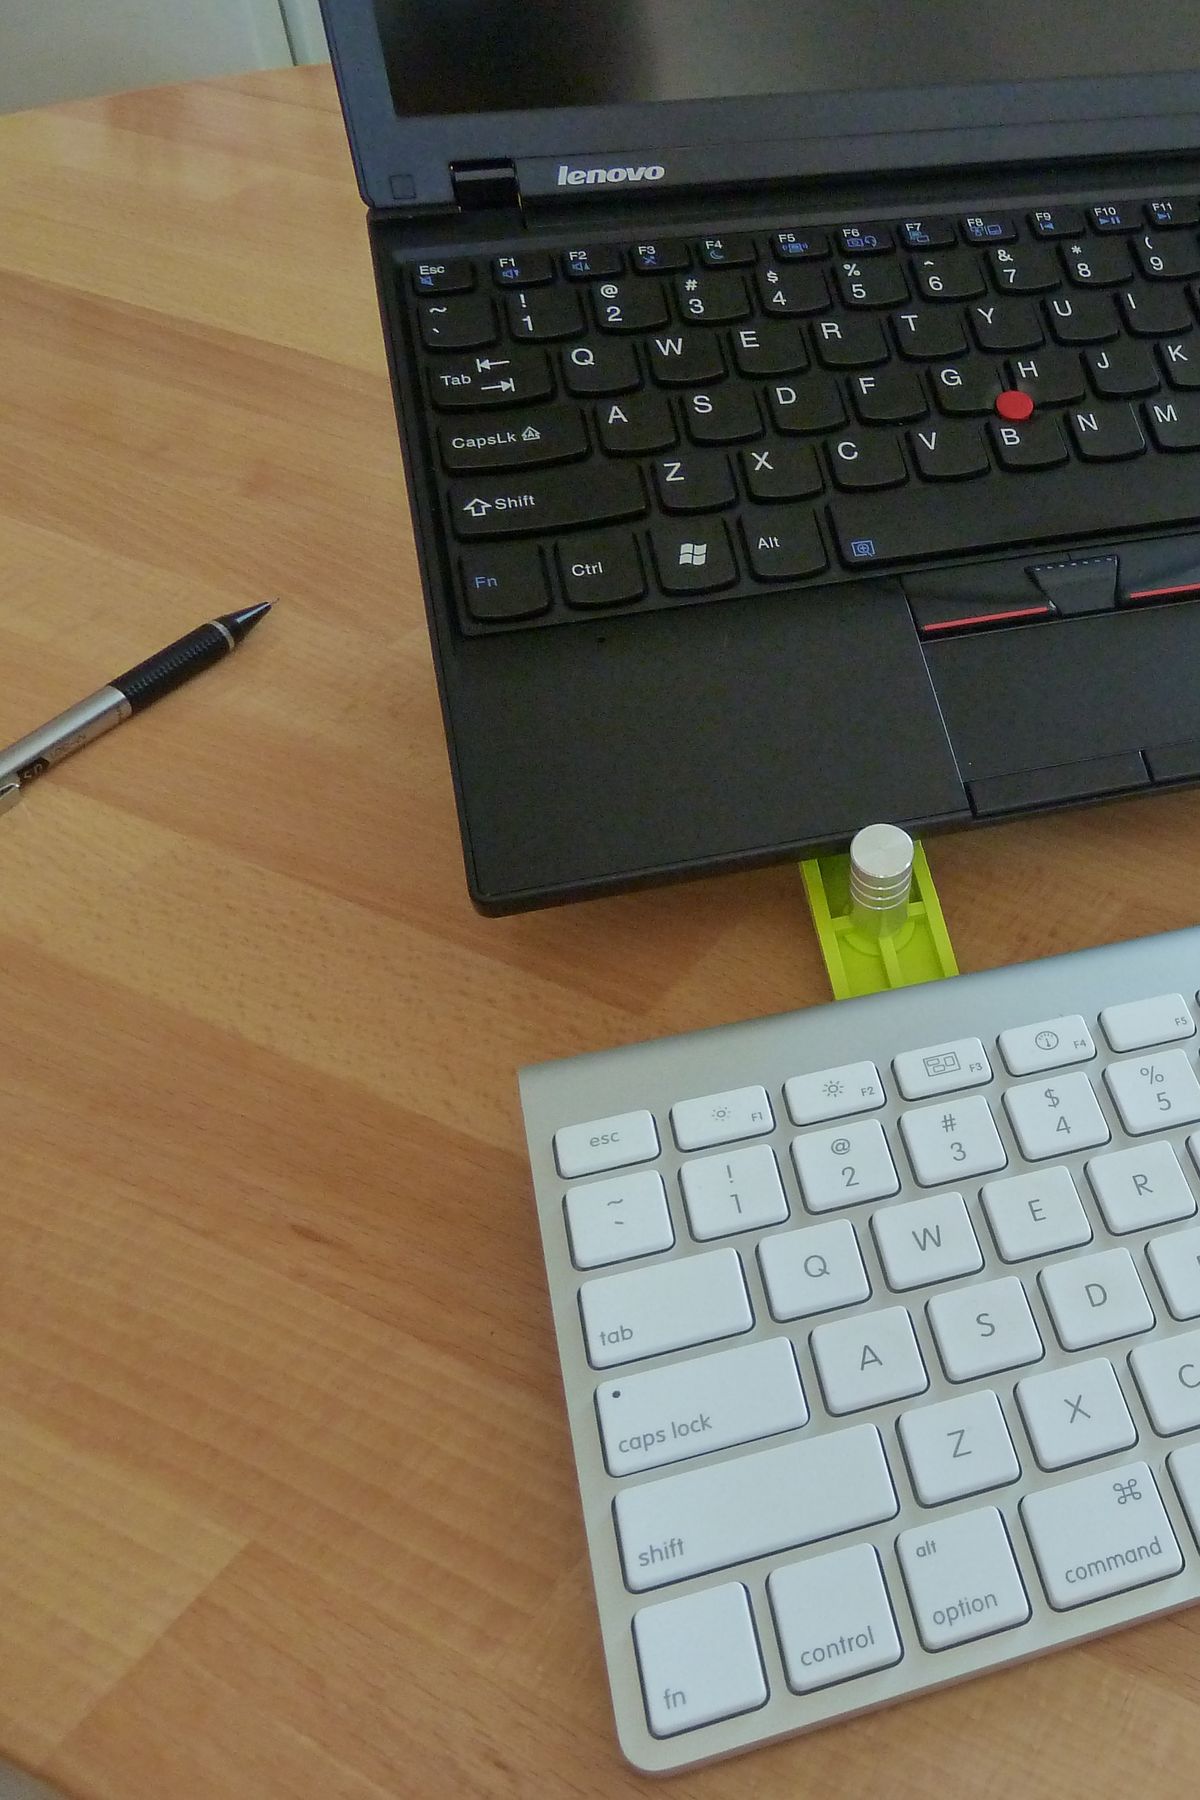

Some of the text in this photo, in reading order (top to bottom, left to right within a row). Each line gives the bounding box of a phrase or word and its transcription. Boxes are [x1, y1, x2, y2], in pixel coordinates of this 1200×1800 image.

[558, 166, 664, 185] lenovo
[1095, 207, 1116, 216] F10
[1152, 202, 1173, 211] F11
[968, 219, 983, 227] F8
[1036, 213, 1051, 221] F9
[843, 229, 859, 237] F6
[906, 223, 920, 231] F7
[706, 241, 722, 249] F4
[779, 234, 795, 242] F5
[570, 251, 587, 260] F2
[639, 246, 655, 254] F3
[998, 250, 1013, 261] &
[420, 266, 444, 274] Esc
[500, 258, 515, 267] F1
[844, 264, 860, 276] %
[1078, 263, 1091, 277] 8
[1150, 257, 1163, 270] 9
[767, 271, 778, 283] $
[929, 277, 942, 290] 6
[1003, 269, 1015, 282] 7
[601, 285, 618, 298] @
[685, 280, 697, 290] #
[852, 284, 865, 298] 5
[520, 294, 526, 307] !
[689, 299, 704, 313] 3
[773, 291, 786, 305] 4
[607, 307, 622, 321] 2
[978, 308, 993, 323] Y
[1054, 301, 1071, 316] U
[522, 316, 532, 330] 1
[821, 323, 841, 339] R
[901, 315, 917, 331] T
[656, 338, 682, 355] W
[740, 331, 759, 347] E
[572, 349, 594, 365] Q
[1098, 353, 1109, 368] J
[1168, 345, 1187, 361] K
[941, 369, 962, 385] G
[1018, 361, 1038, 377] H
[440, 374, 471, 385] Tab
[859, 378, 874, 394] F
[776, 388, 796, 404] D
[694, 396, 712, 413] S
[609, 406, 628, 423] A
[1154, 405, 1177, 422] M
[1077, 414, 1098, 431] N
[452, 433, 516, 448] CapsLk
[919, 432, 936, 449] V
[1001, 429, 1020, 445] B
[838, 442, 858, 459] C
[752, 452, 773, 470] X
[664, 463, 684, 481] Z
[495, 495, 535, 509] Shift
[759, 537, 779, 549] Alt
[572, 562, 602, 576] Ctrl
[476, 577, 497, 588] Fn
[1175, 1017, 1187, 1026] F5
[1074, 1040, 1086, 1048] F4
[969, 1063, 982, 1072] F3
[1140, 1066, 1164, 1084] %
[861, 1087, 874, 1096] F2
[1045, 1088, 1059, 1108] $
[1157, 1092, 1171, 1110] 5
[752, 1112, 762, 1121] F1
[942, 1114, 956, 1132] #
[1056, 1116, 1071, 1133] 4
[590, 1132, 619, 1147] esc
[831, 1139, 850, 1155] @
[951, 1142, 966, 1161] 3
[727, 1165, 733, 1183] !
[842, 1167, 859, 1186] 2
[1132, 1174, 1153, 1195] R
[730, 1194, 741, 1213] 1
[1028, 1199, 1046, 1221] E
[912, 1225, 941, 1251] W
[804, 1255, 830, 1277] Q
[1085, 1284, 1107, 1307] D
[976, 1313, 995, 1336] S
[600, 1326, 633, 1345] tab
[861, 1345, 882, 1370] A
[1179, 1364, 1200, 1388] C
[1064, 1395, 1090, 1423] X
[619, 1414, 712, 1452] caps lock
[947, 1430, 971, 1458] Z
[639, 1538, 683, 1566] shift
[916, 1541, 936, 1557] alt
[1066, 1536, 1162, 1583] command
[933, 1594, 998, 1626] option
[801, 1626, 874, 1666] control
[664, 1689, 686, 1709] fn
